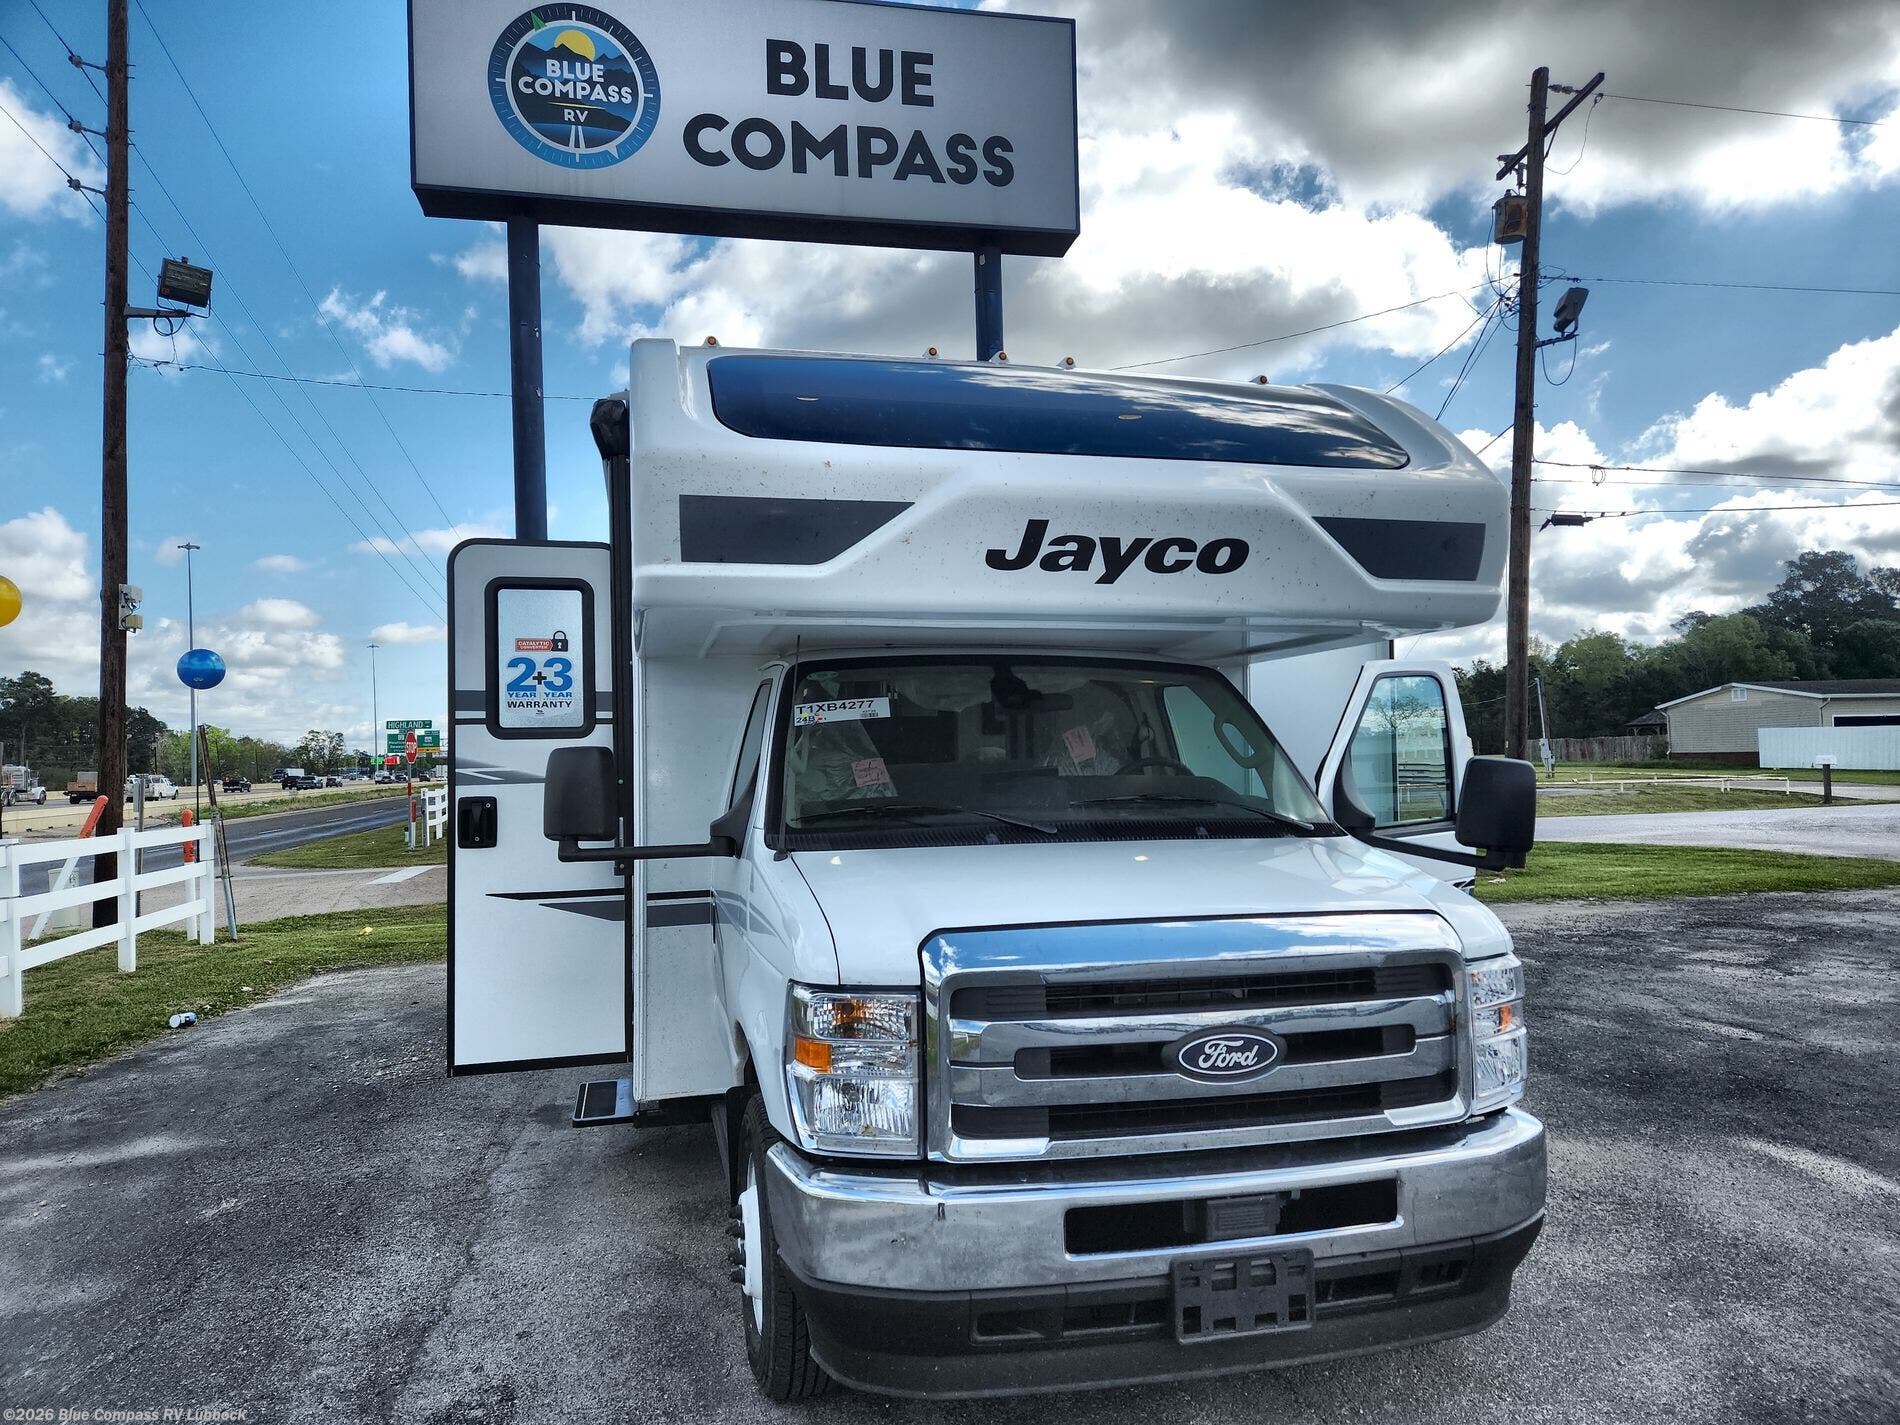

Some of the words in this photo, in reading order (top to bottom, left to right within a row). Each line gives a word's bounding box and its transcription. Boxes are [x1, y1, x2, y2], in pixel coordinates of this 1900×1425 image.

[546, 59, 604, 82] BLUE
[766, 38, 934, 107] BLUE
[518, 76, 633, 104] COMPASS
[564, 108, 588, 122] RV
[683, 113, 1015, 187] COMPASS
[985, 519, 1250, 585] Jayco
[796, 700, 874, 714] T1XB4277
[388, 721, 424, 729] HIGHLAND
[406, 742, 416, 753] STOP
[1198, 1039, 1259, 1069] Ford
